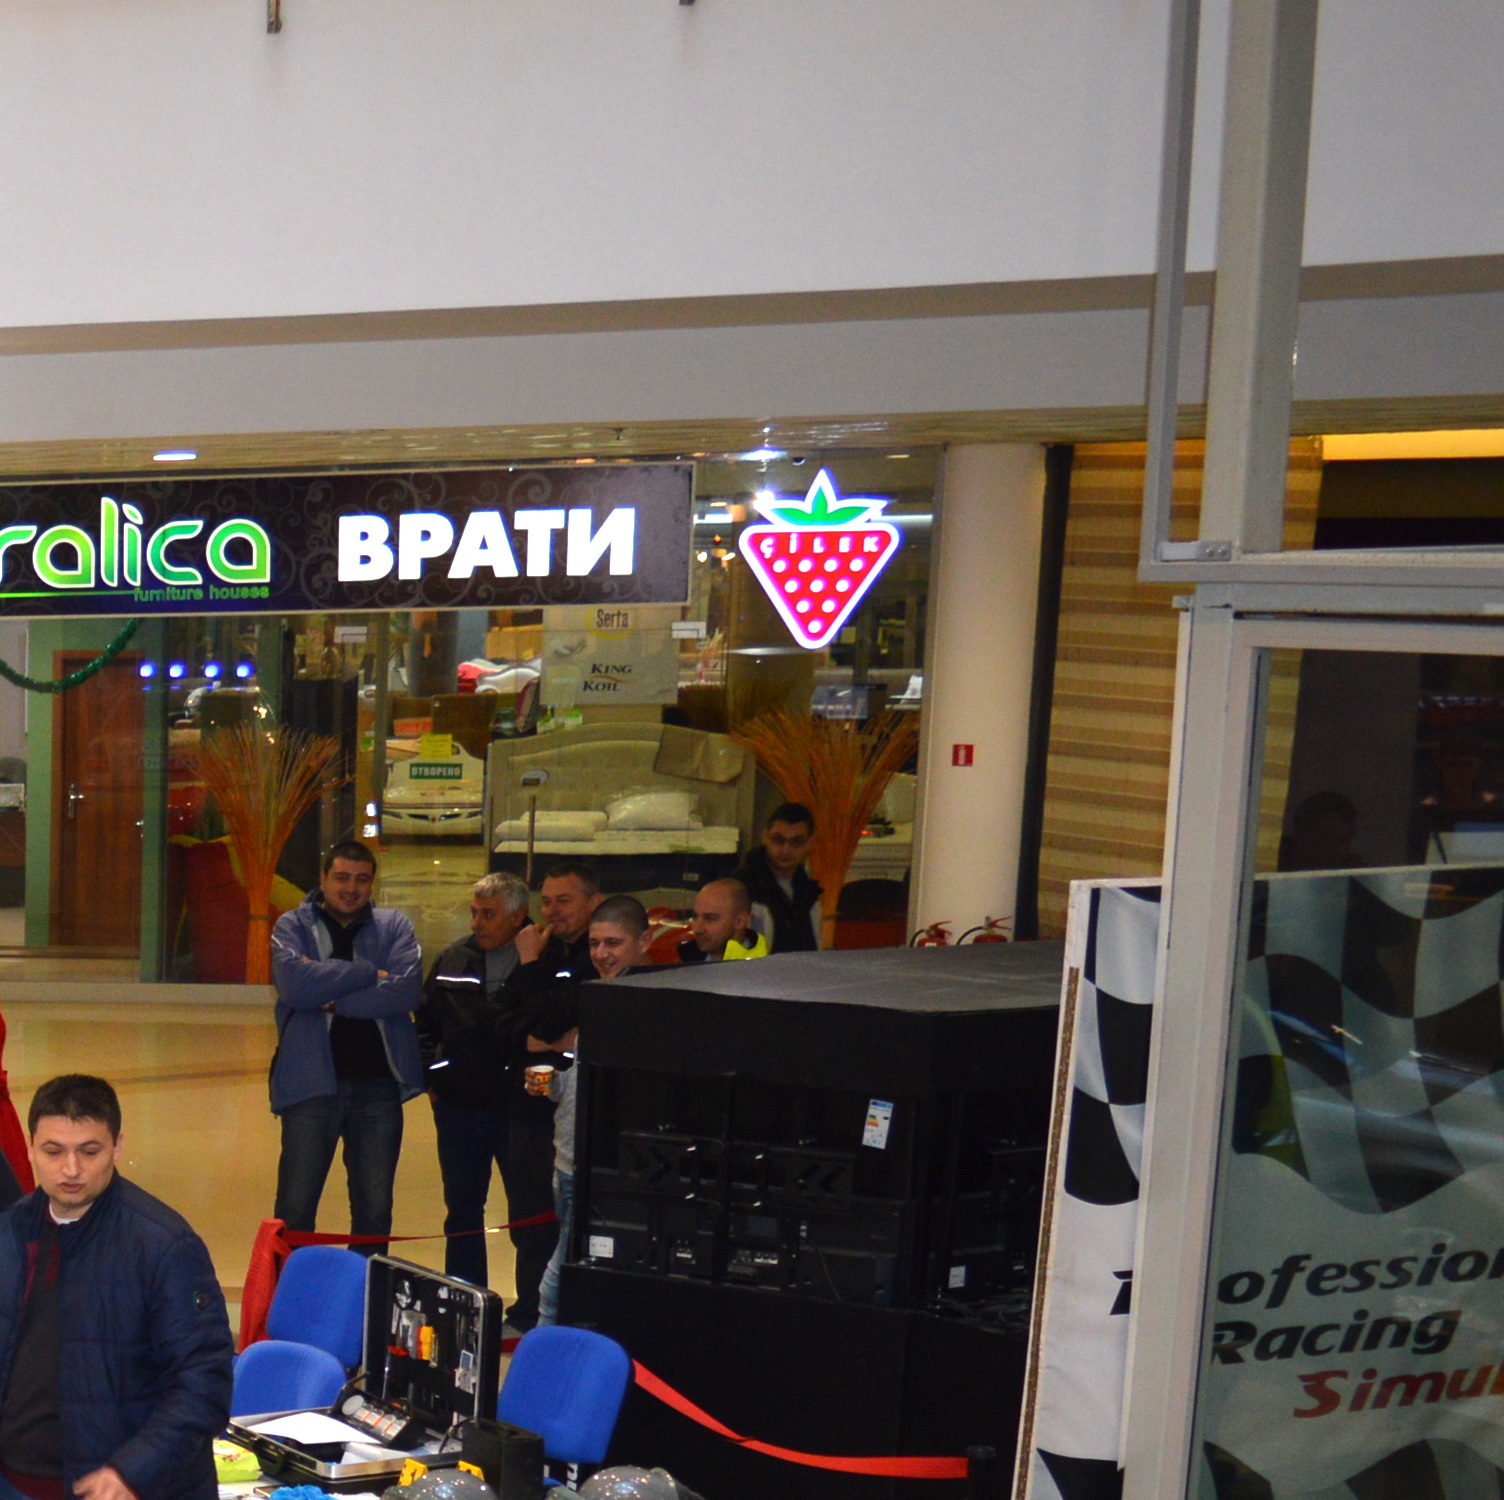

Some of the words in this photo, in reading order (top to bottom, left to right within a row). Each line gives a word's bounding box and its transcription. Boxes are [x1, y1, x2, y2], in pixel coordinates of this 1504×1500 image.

[338, 507, 636, 582] ВРАТИ
[133, 585, 204, 602] furniture
[209, 583, 270, 599] houses
[596, 609, 629, 628] Serta
[591, 663, 632, 674] KING
[583, 681, 621, 692] KOIL
[411, 766, 460, 777] ОТВОРЕНО
[1211, 1309, 1461, 1367] Racing
